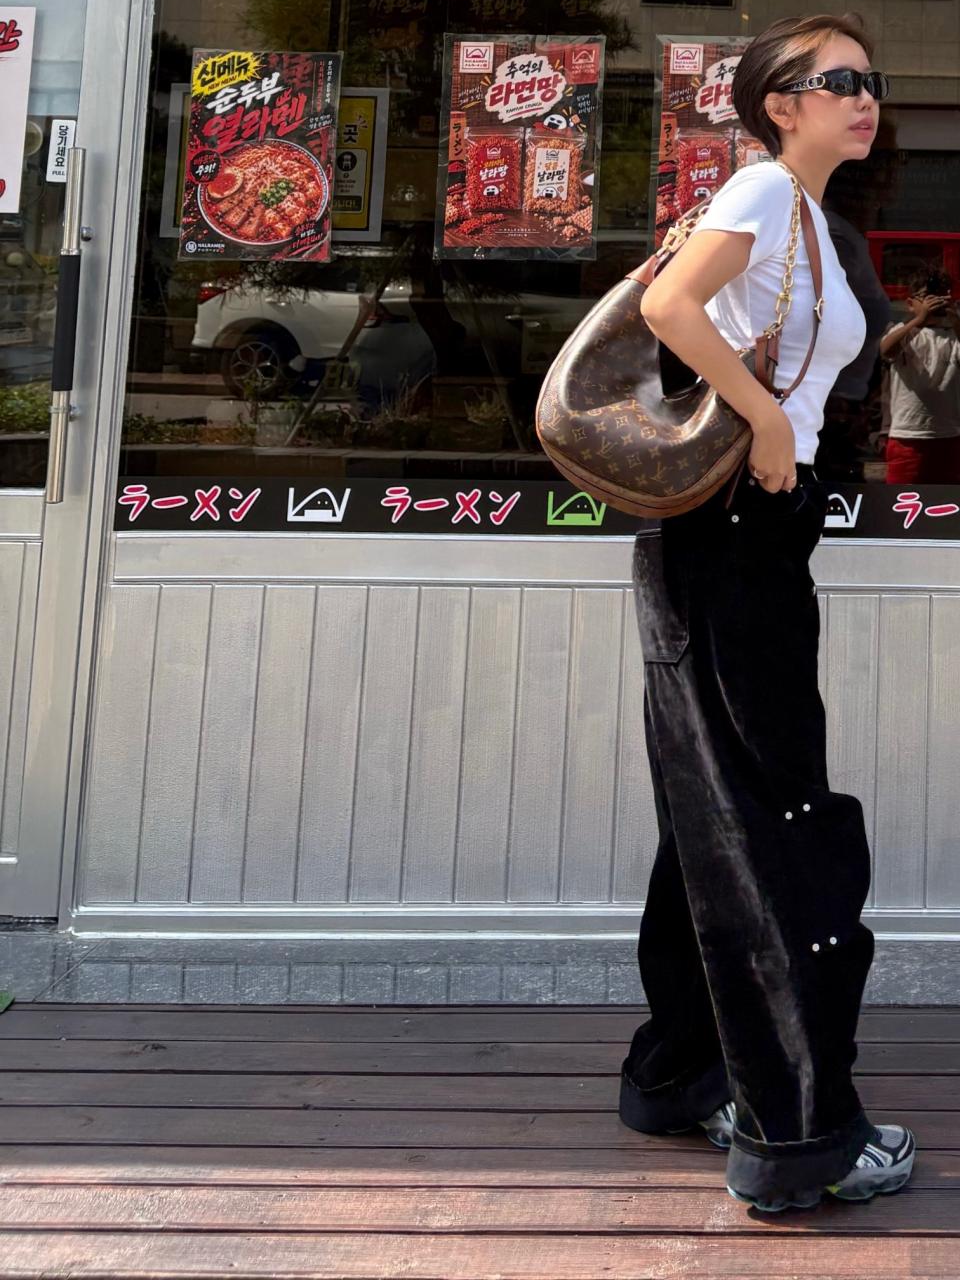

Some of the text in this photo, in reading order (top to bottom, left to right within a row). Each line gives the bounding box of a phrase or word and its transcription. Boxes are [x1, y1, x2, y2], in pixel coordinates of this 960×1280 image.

[198, 54, 251, 86] 신메뉴
[505, 59, 544, 79] 추억의
[206, 71, 285, 114] 순두부
[489, 74, 563, 108] 라면땅
[202, 91, 309, 154] 열라멘
[54, 125, 70, 168] 당기세요
[452, 123, 463, 156] ラーメン
[663, 124, 674, 157] ラーメン
[51, 169, 66, 177] PULL
[479, 164, 509, 181] 날라땅
[537, 168, 567, 183] 날라땅
[689, 166, 719, 181] 날라땅
[118, 483, 262, 523] ラーメン
[380, 485, 522, 526] ラーメン
